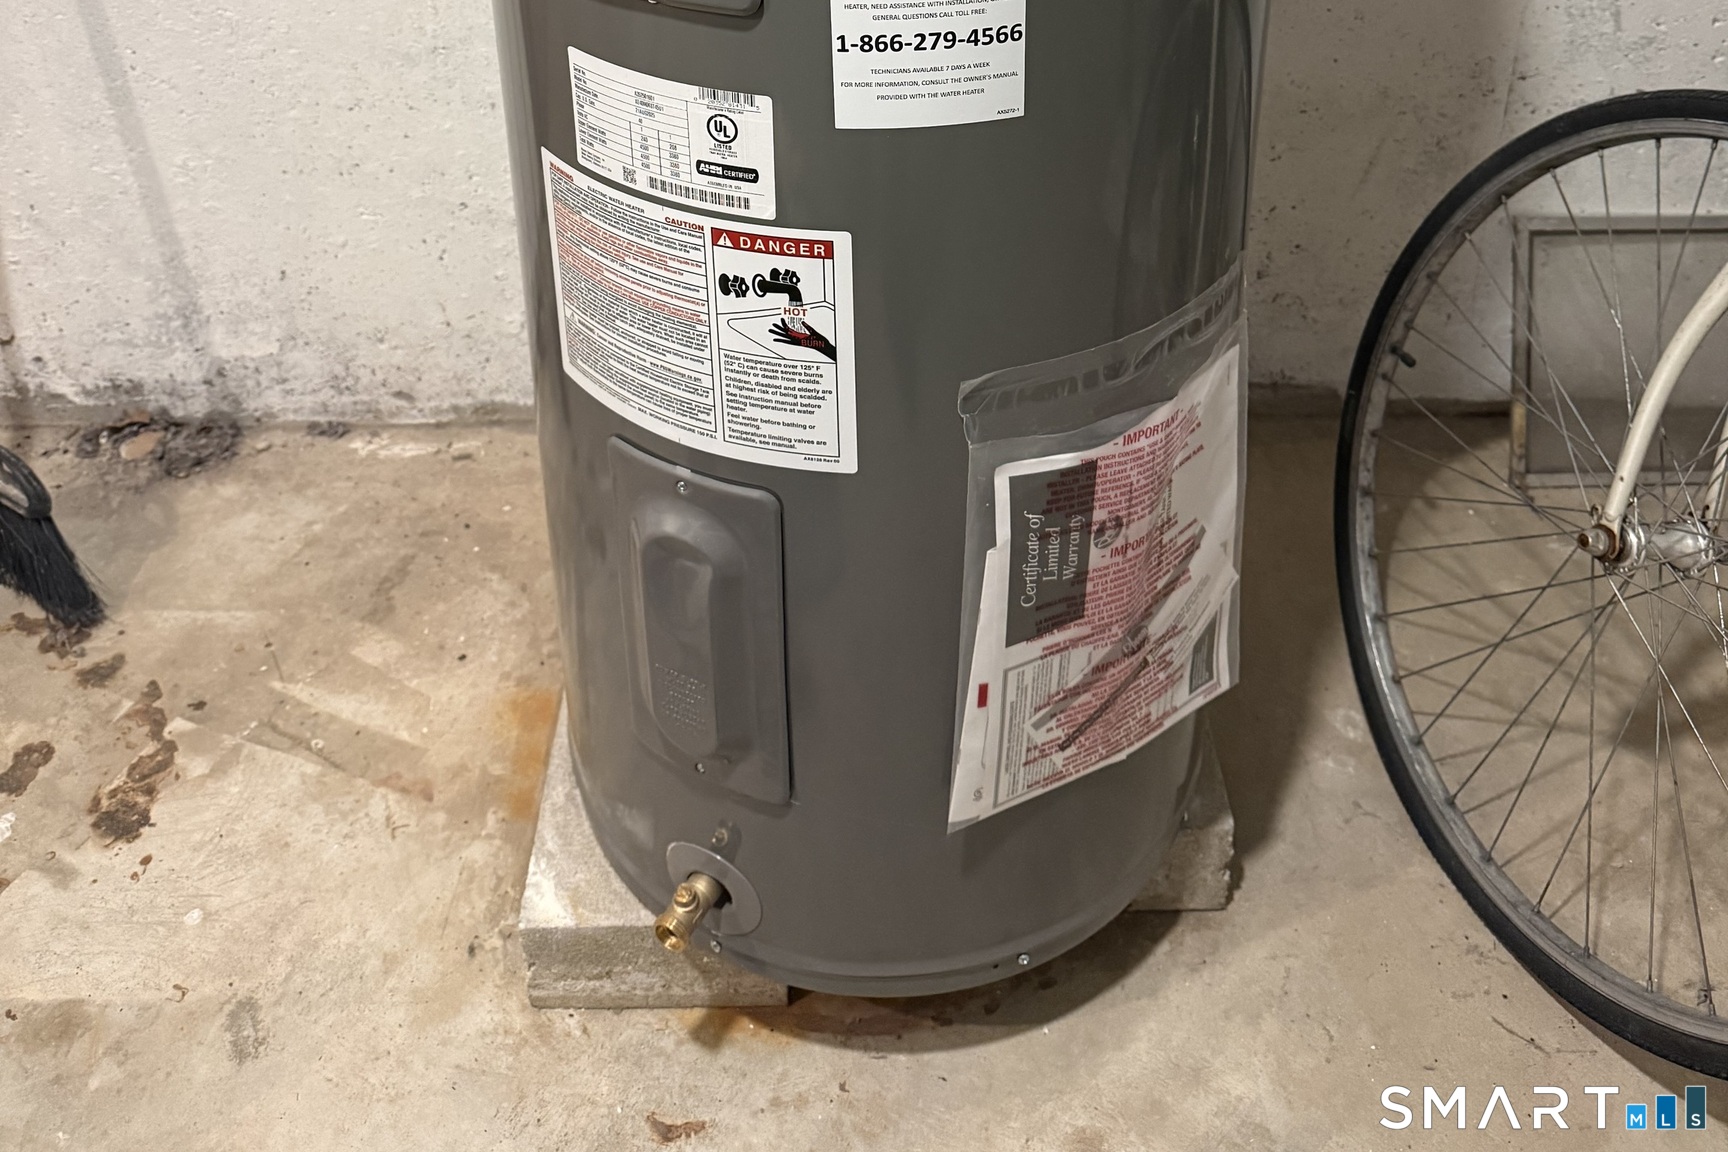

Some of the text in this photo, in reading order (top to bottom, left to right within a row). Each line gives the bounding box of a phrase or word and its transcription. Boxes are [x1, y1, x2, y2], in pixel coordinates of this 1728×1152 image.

[844, 3, 870, 11] HEATER,
[902, 12, 938, 21] QUESTIONS
[836, 23, 1023, 53] 1-866-279-4566
[870, 67, 911, 75] TECHNICIANS
[972, 61, 991, 69] WEEK
[874, 80, 920, 88] INFORMATION,
[921, 78, 949, 86] CONSULT
[963, 75, 992, 83] OWNER'S
[992, 71, 1019, 80] MANUAL
[714, 119, 731, 139] UL
[714, 143, 732, 151] LISTED
[723, 169, 755, 180] CERTIFIED
[587, 185, 645, 214] ELECTRIC WATER HEATER
[664, 216, 705, 232] CAUTION
[739, 236, 826, 257] DANGER
[783, 307, 808, 317] HOT
[801, 339, 825, 348] BURN
[723, 353, 741, 362] Water
[743, 357, 782, 368] temperature
[760, 366, 779, 374] cause
[780, 369, 803, 377] severe
[1122, 408, 1180, 446] IMPORTANT
[1042, 526, 1060, 581] Limited
[1063, 514, 1085, 581] Warranty
[1021, 510, 1044, 607] Certificate of
